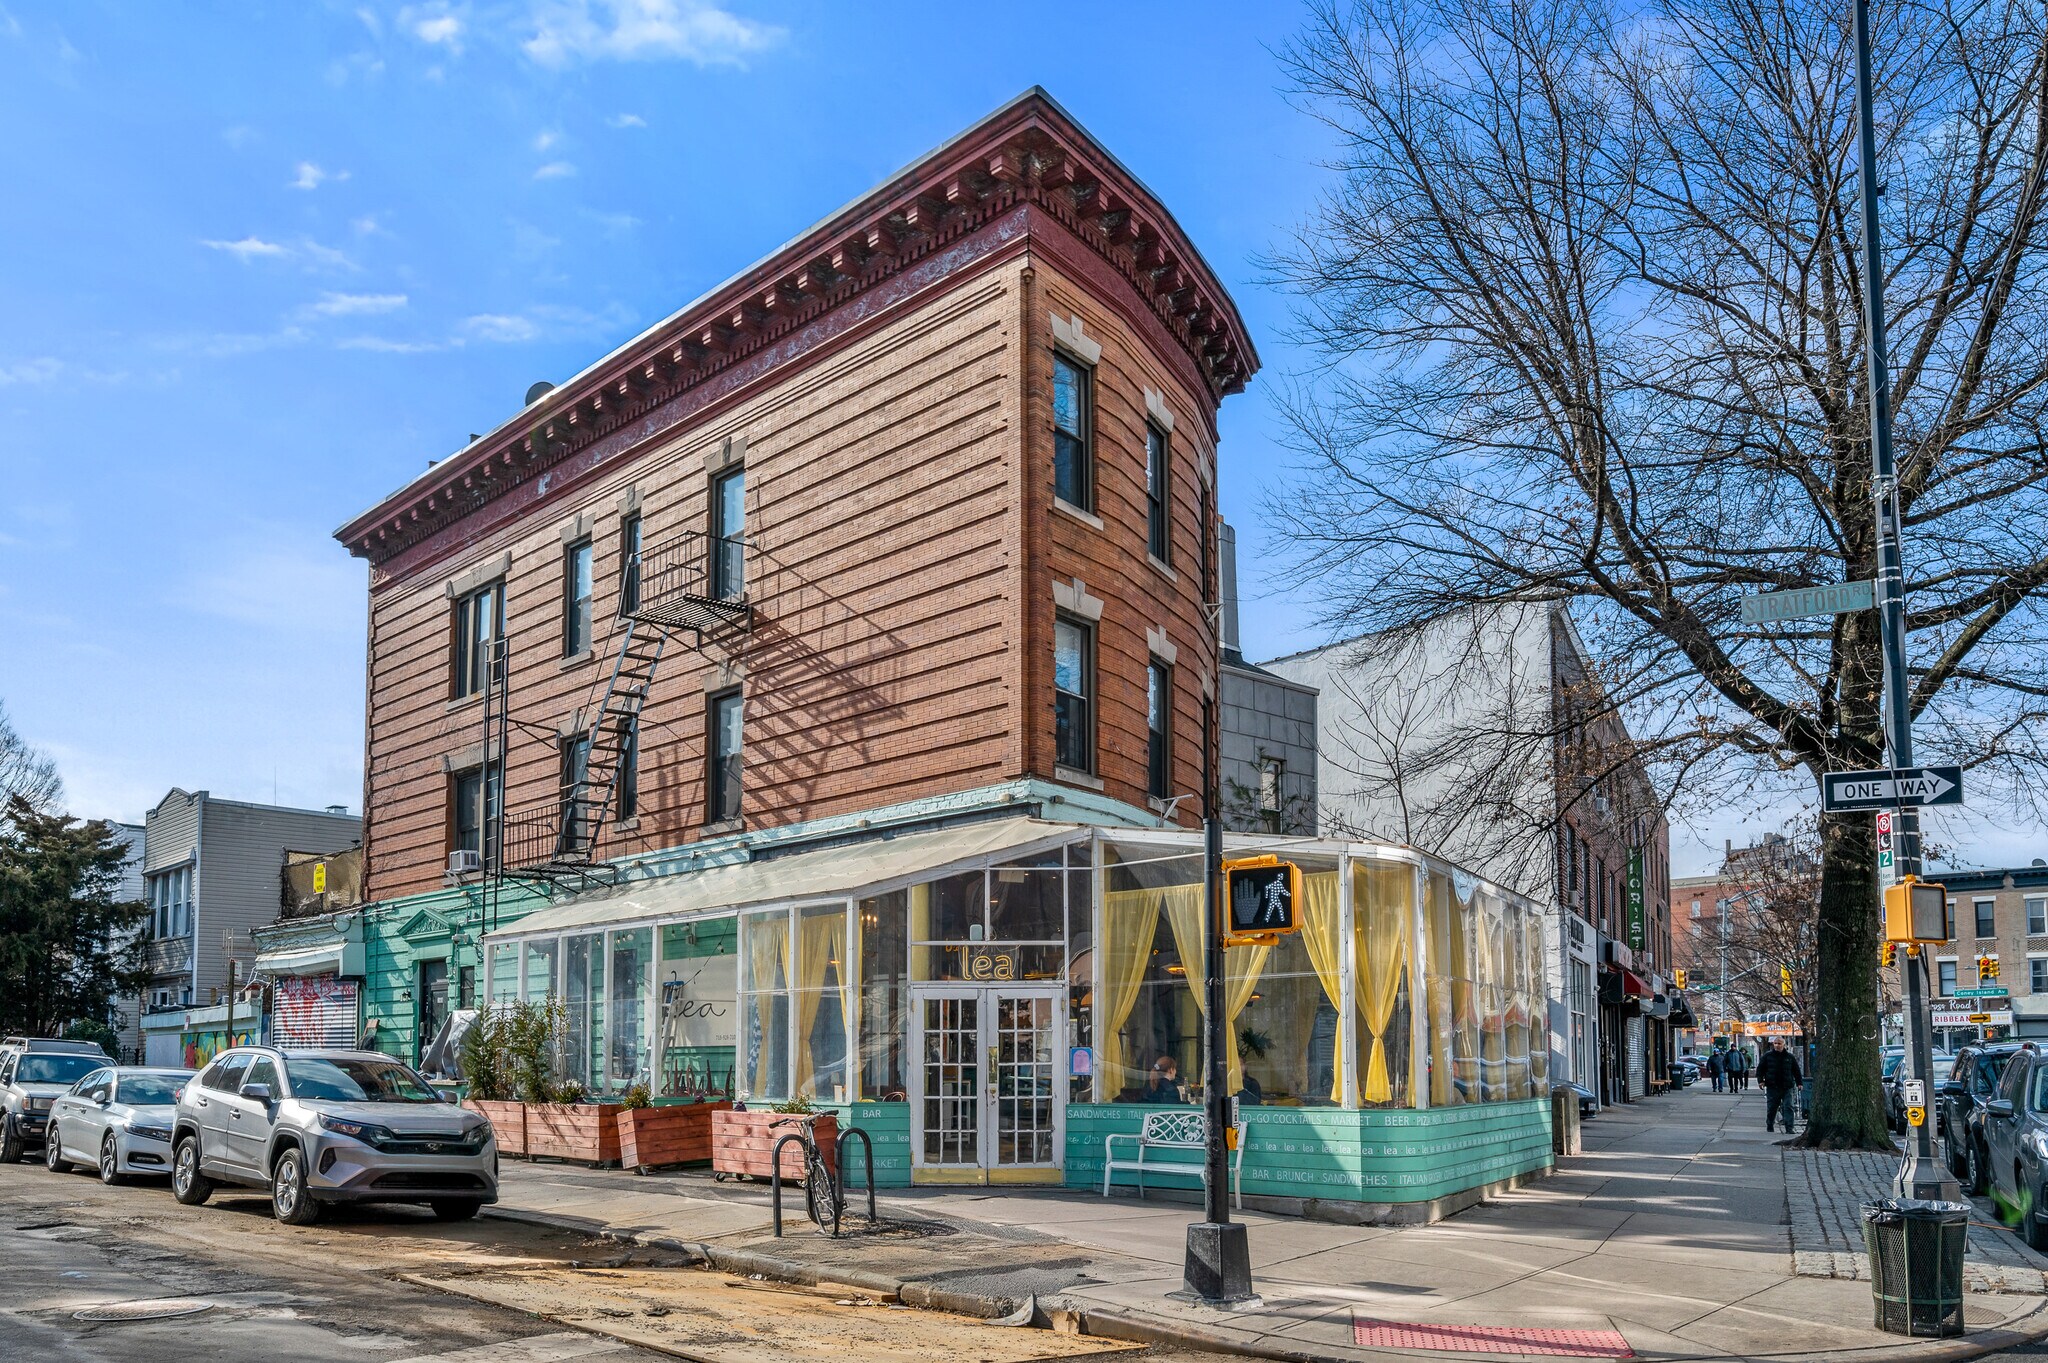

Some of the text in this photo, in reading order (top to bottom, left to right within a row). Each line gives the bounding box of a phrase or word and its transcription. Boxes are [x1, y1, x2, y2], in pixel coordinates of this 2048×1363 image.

[1745, 585, 1871, 620] STRATFORD RD
[1844, 779, 1941, 799] ONE WAY
[1882, 851, 1890, 866] 2
[961, 944, 1014, 980] lea
[1949, 999, 1972, 1010] Road
[1934, 1015, 1971, 1023] RIBBEAN
[862, 1109, 882, 1118] BAR
[1067, 1109, 1121, 1120] SANDWICHES
[1240, 1112, 1270, 1123] TO-GO
[1273, 1113, 1322, 1125] COCKTAILS
[1330, 1115, 1371, 1127] MARKET
[1384, 1115, 1410, 1126] BEER
[877, 1133, 910, 1142] lea lea
[1265, 1141, 1277, 1151] lea
[1284, 1142, 1295, 1152] lea
[1302, 1142, 1314, 1153] lea
[1321, 1143, 1333, 1154] lea
[1339, 1143, 1351, 1154] lea
[1383, 1145, 1398, 1155] lea
[1405, 1145, 1416, 1155] lea
[858, 1158, 899, 1168] MRKET
[1252, 1169, 1270, 1180] BAR
[1276, 1171, 1314, 1182] BRUNCH
[1322, 1172, 1388, 1186] SANDWICHES
[1399, 1174, 1429, 1185] ITALIAN
